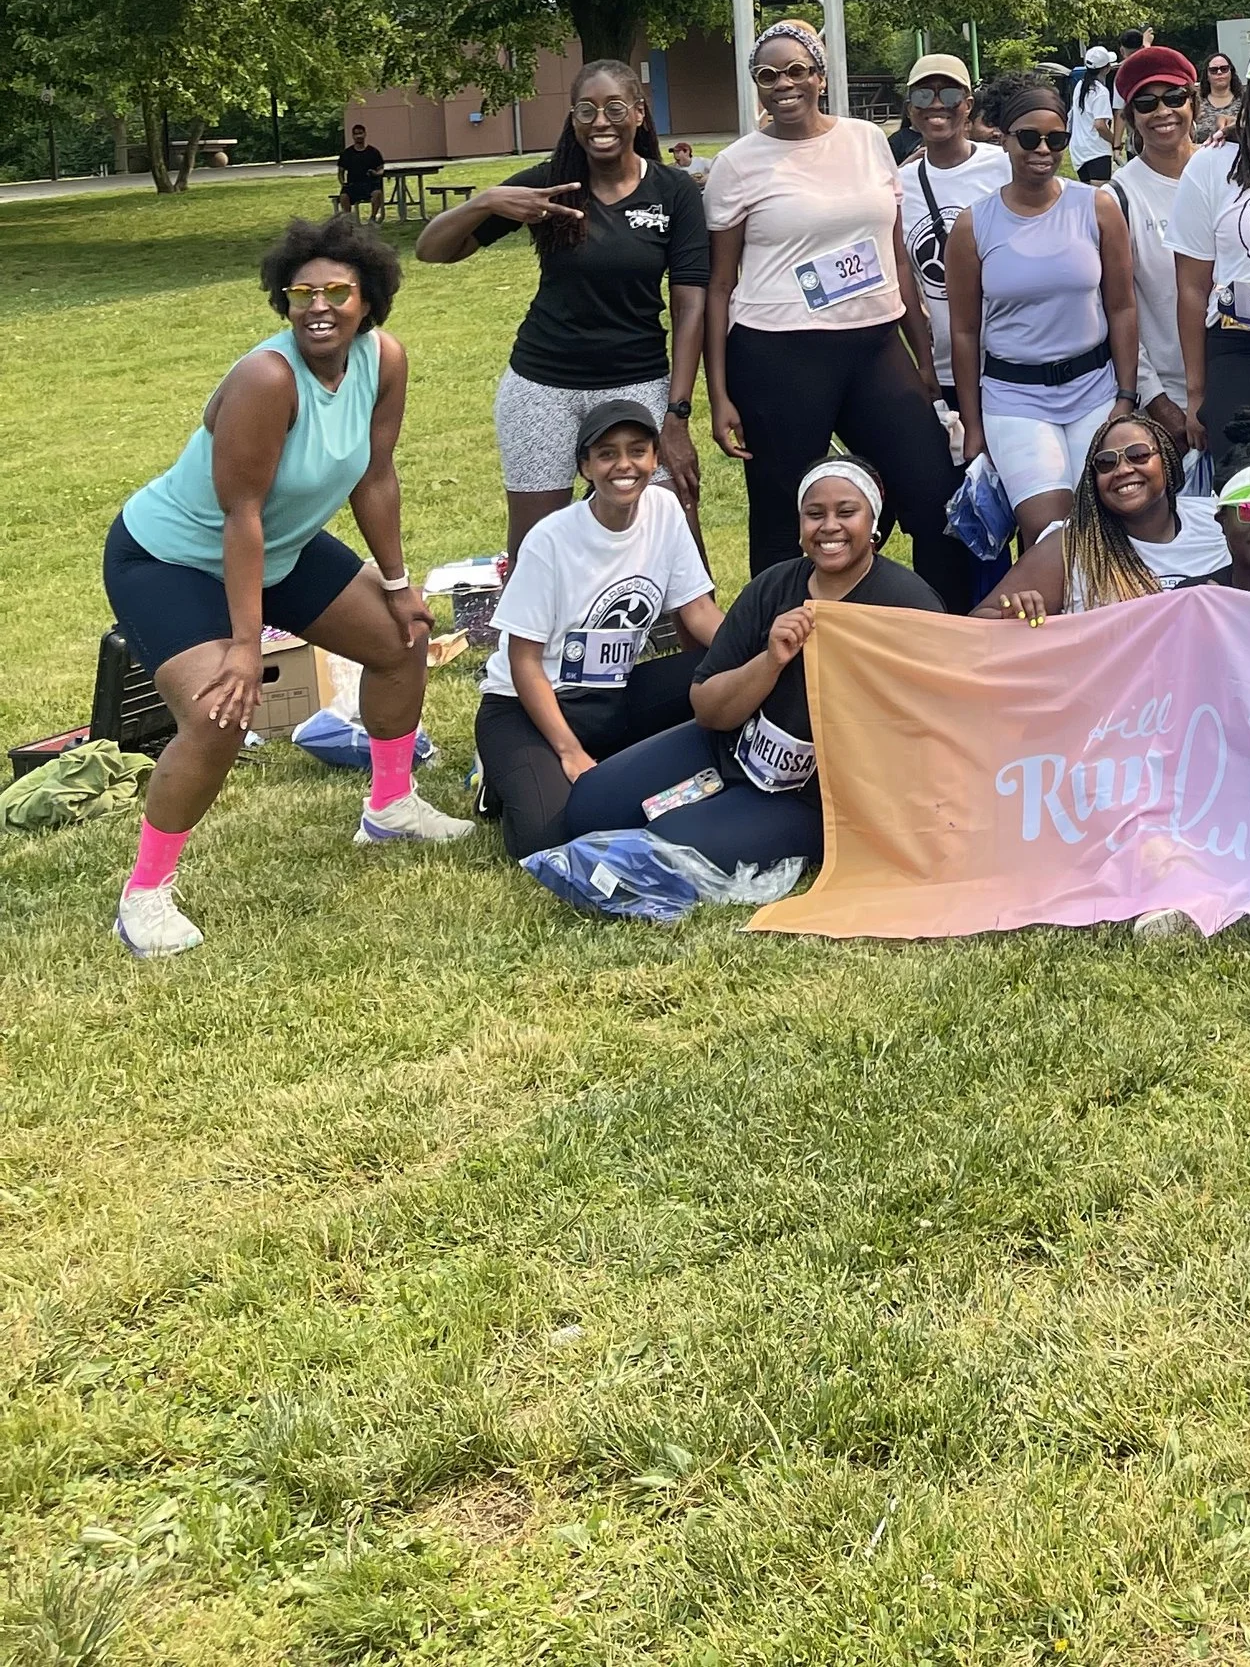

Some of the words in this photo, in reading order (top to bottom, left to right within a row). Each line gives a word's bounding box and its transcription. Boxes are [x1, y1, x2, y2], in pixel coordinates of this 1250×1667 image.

[835, 254, 864, 279] 322
[752, 729, 814, 773] MELISSA
[995, 748, 1165, 844] Run
